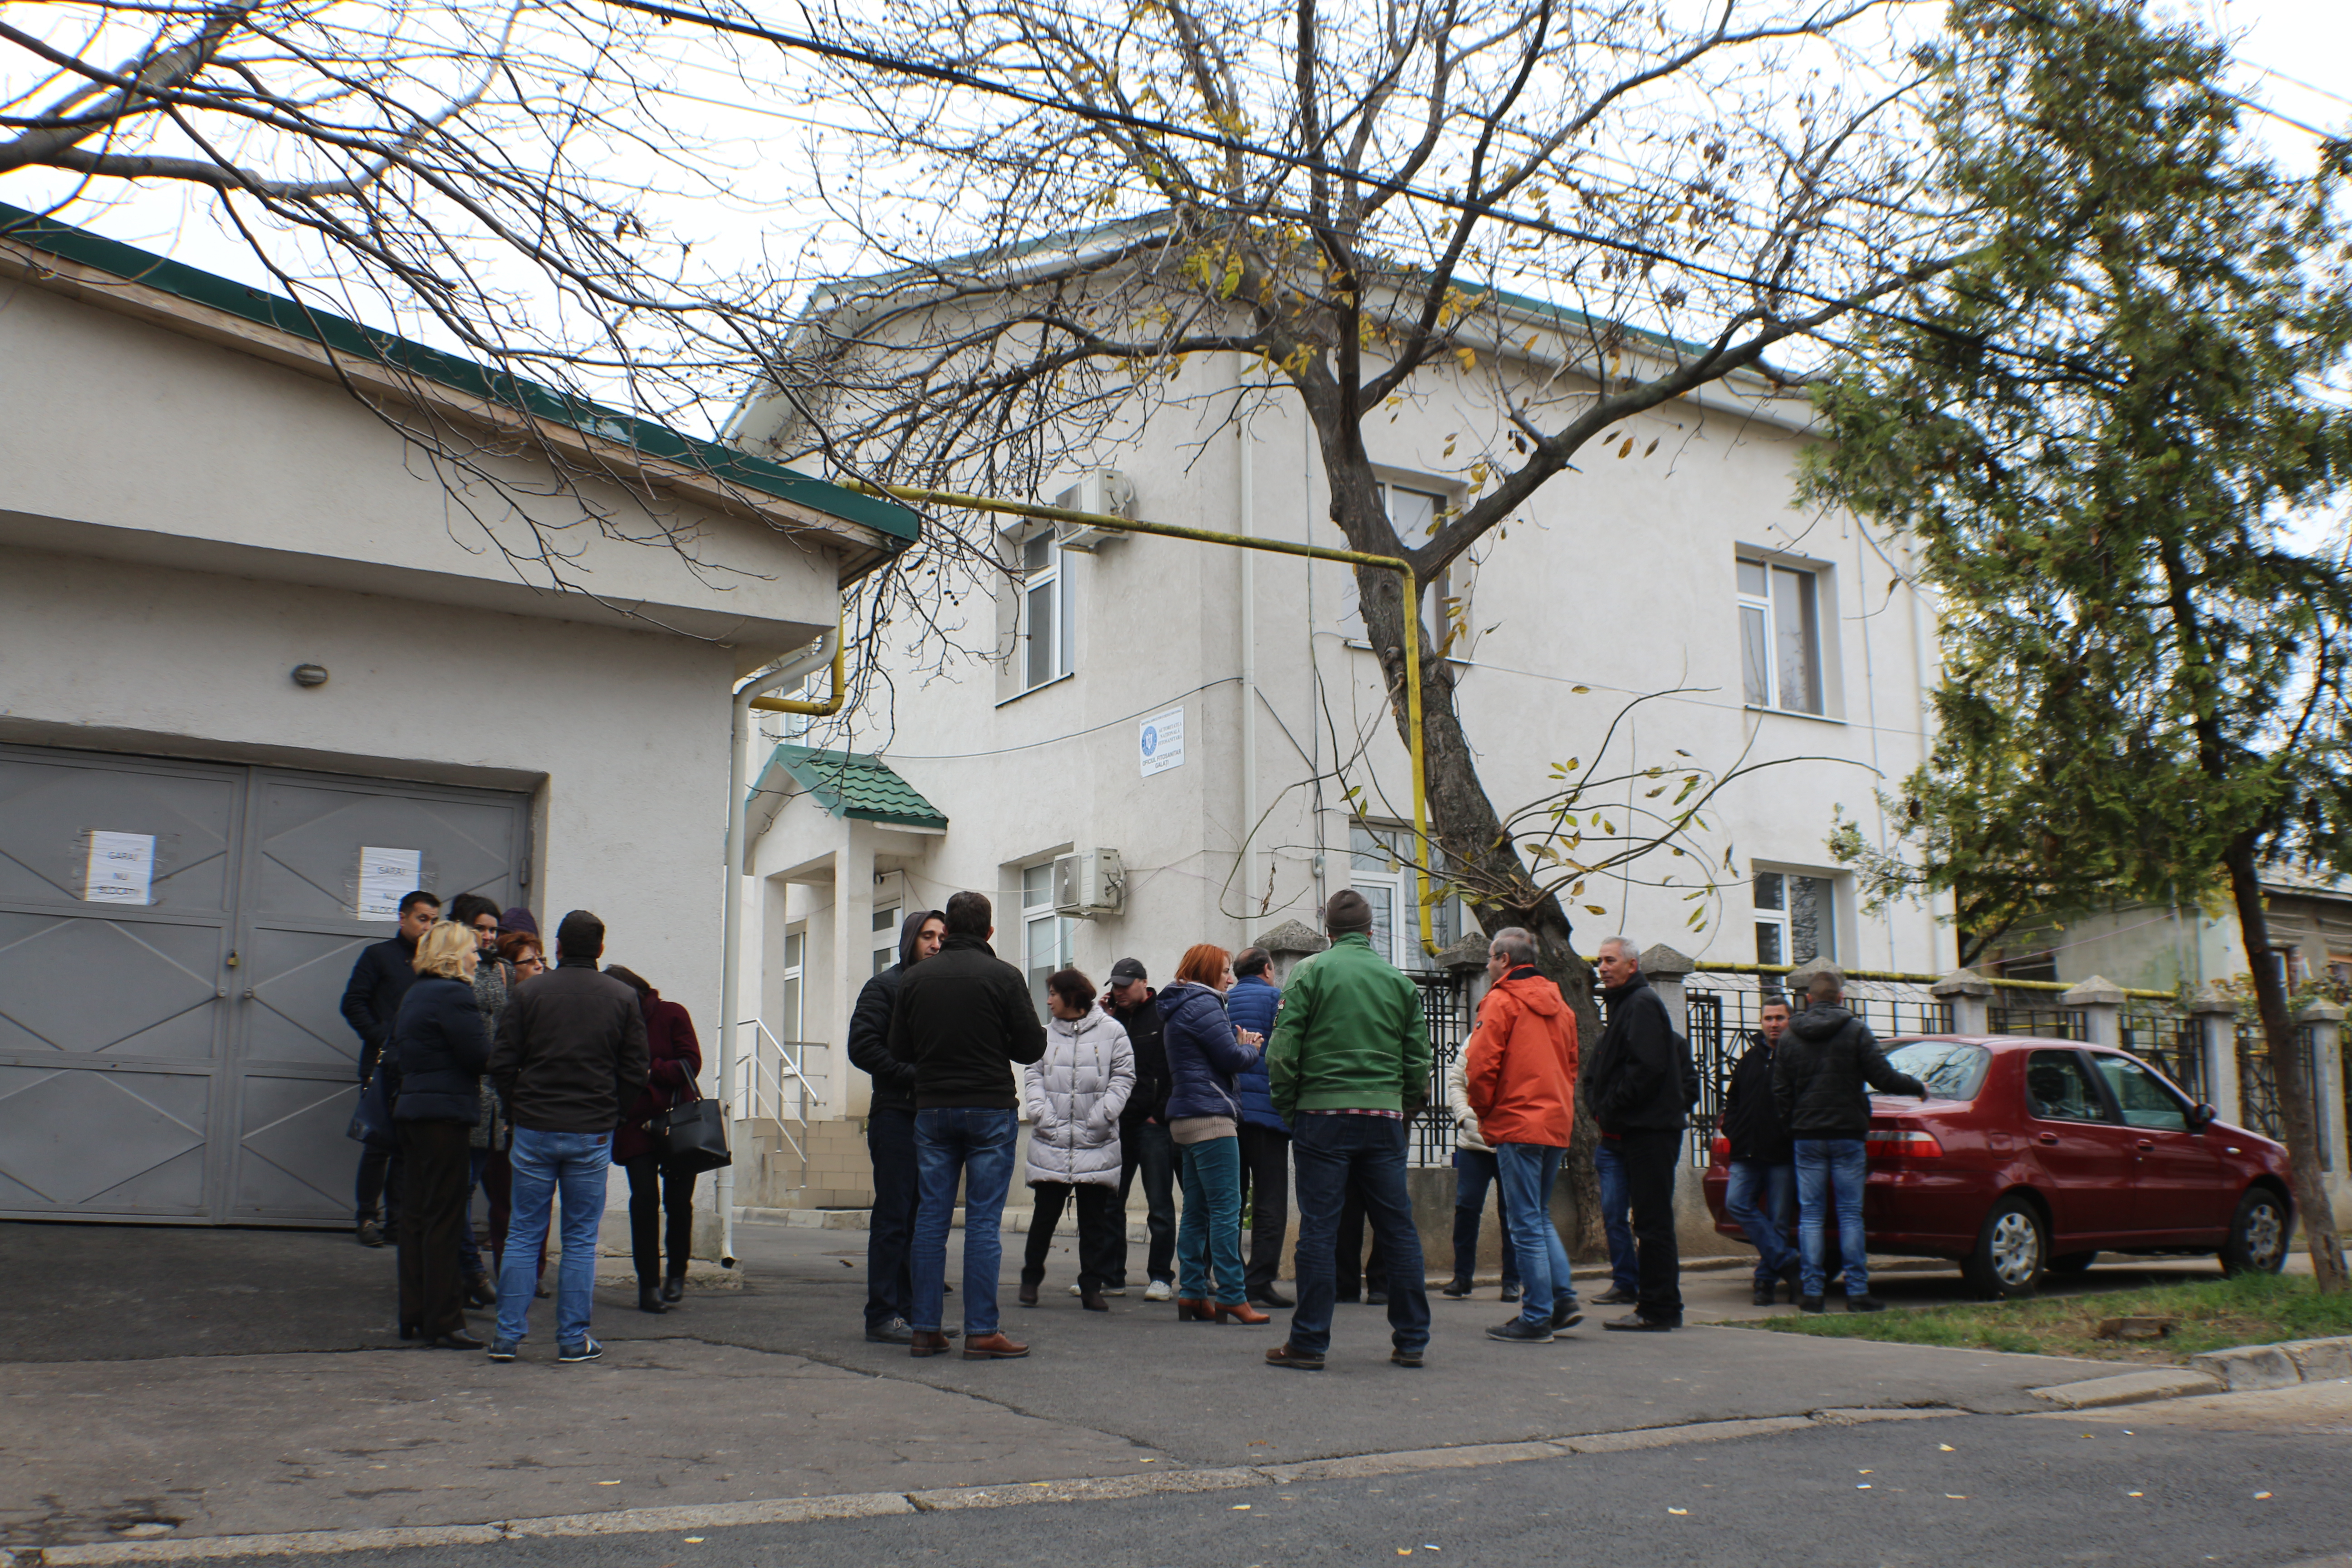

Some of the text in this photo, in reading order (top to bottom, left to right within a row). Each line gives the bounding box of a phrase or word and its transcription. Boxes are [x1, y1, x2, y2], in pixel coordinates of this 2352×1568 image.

[1142, 749, 1181, 766] OFICIUL FITOSANITAR
[108, 852, 139, 862] GARAJ
[377, 867, 407, 876] GARAJ
[113, 872, 129, 881] NU
